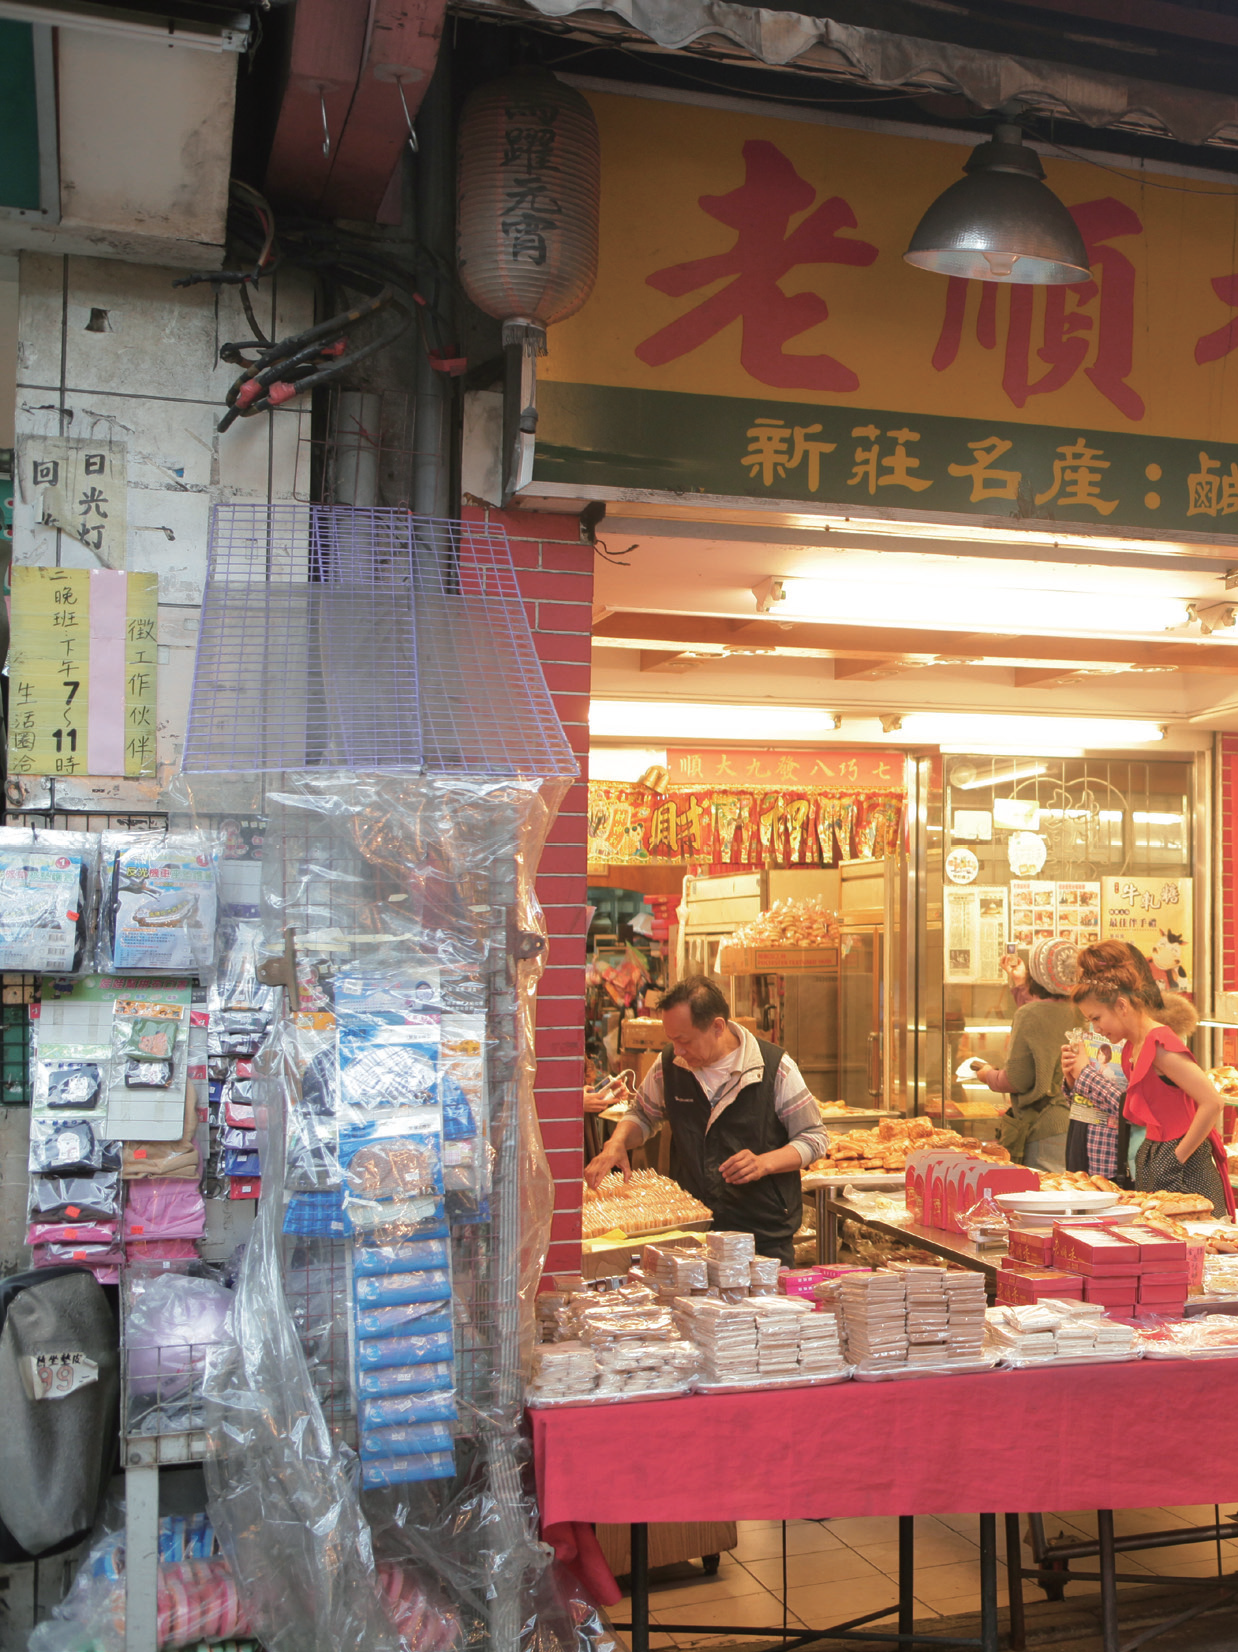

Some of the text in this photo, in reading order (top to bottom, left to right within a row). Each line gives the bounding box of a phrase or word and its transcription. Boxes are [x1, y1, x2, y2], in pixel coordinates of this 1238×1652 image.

[76, 452, 110, 551] 日光灯
[13, 681, 38, 773] 生活圈洽
[127, 618, 157, 766] 徵工作伙伴
